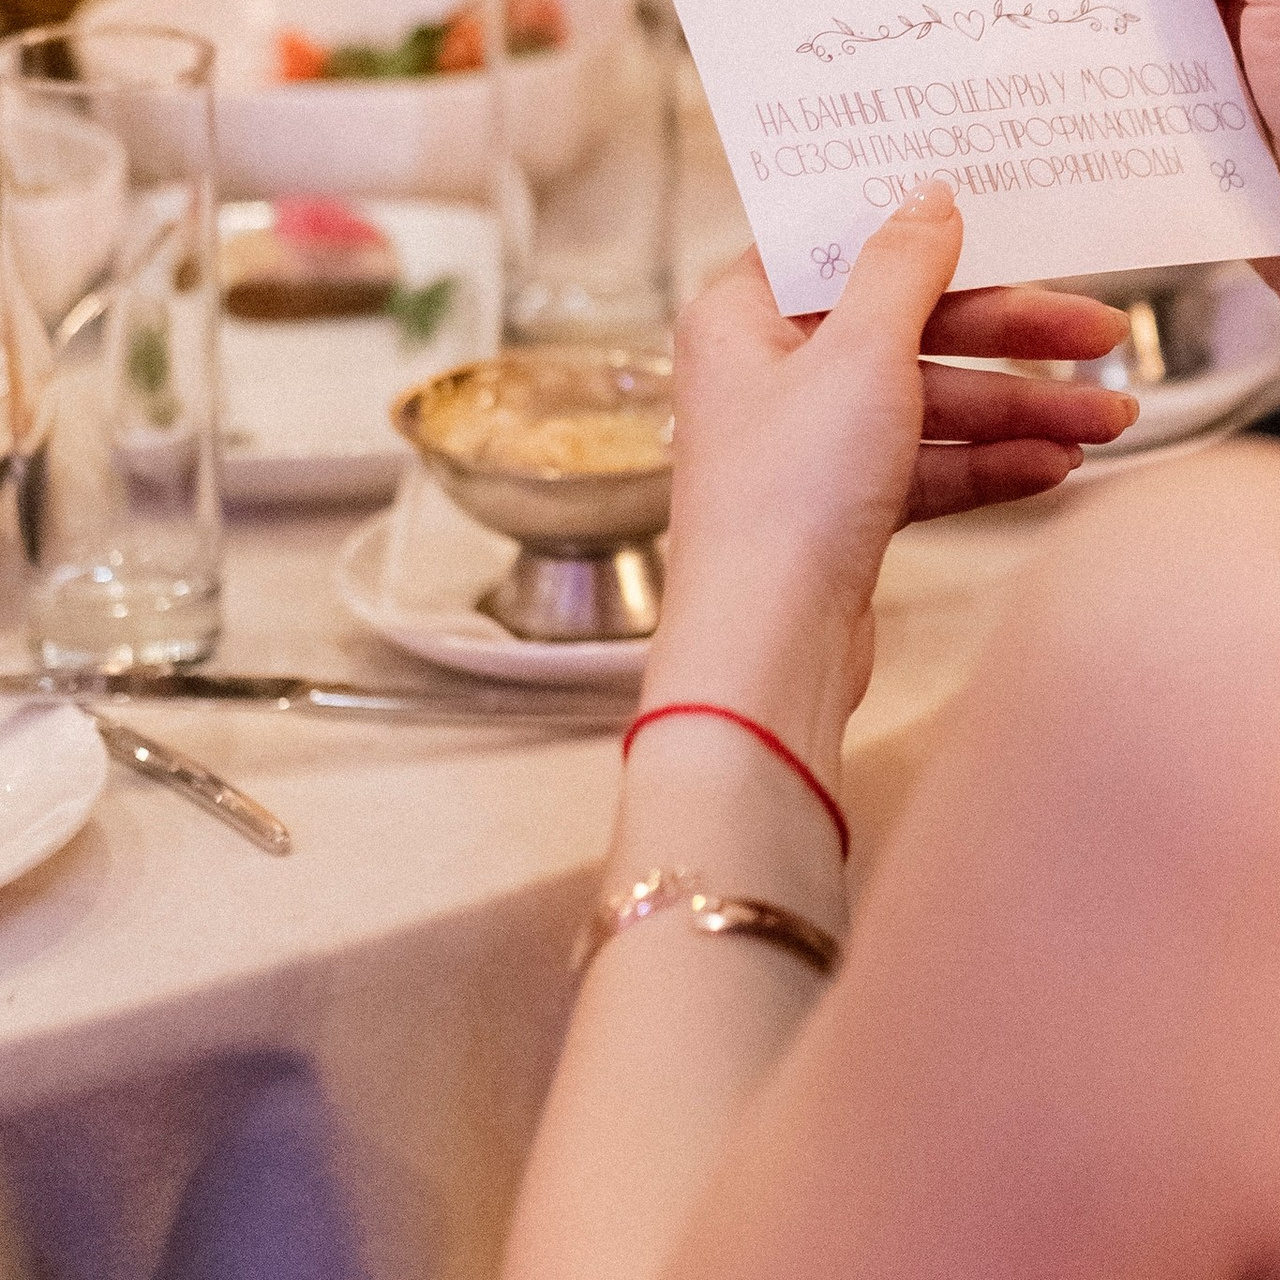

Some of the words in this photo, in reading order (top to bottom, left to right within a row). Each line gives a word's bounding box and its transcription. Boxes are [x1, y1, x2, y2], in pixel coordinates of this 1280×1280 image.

[755, 101, 800, 137] НА
[798, 88, 894, 133] БАННЫЕ
[893, 69, 1052, 121] ПРОЦЕДУРЫ
[1049, 69, 1067, 104] У
[1080, 59, 1219, 103] МОЛОДЫХ
[750, 149, 770, 182] В
[774, 137, 870, 178] СЕЗОН
[1112, 146, 1186, 182] ВОДЫ
